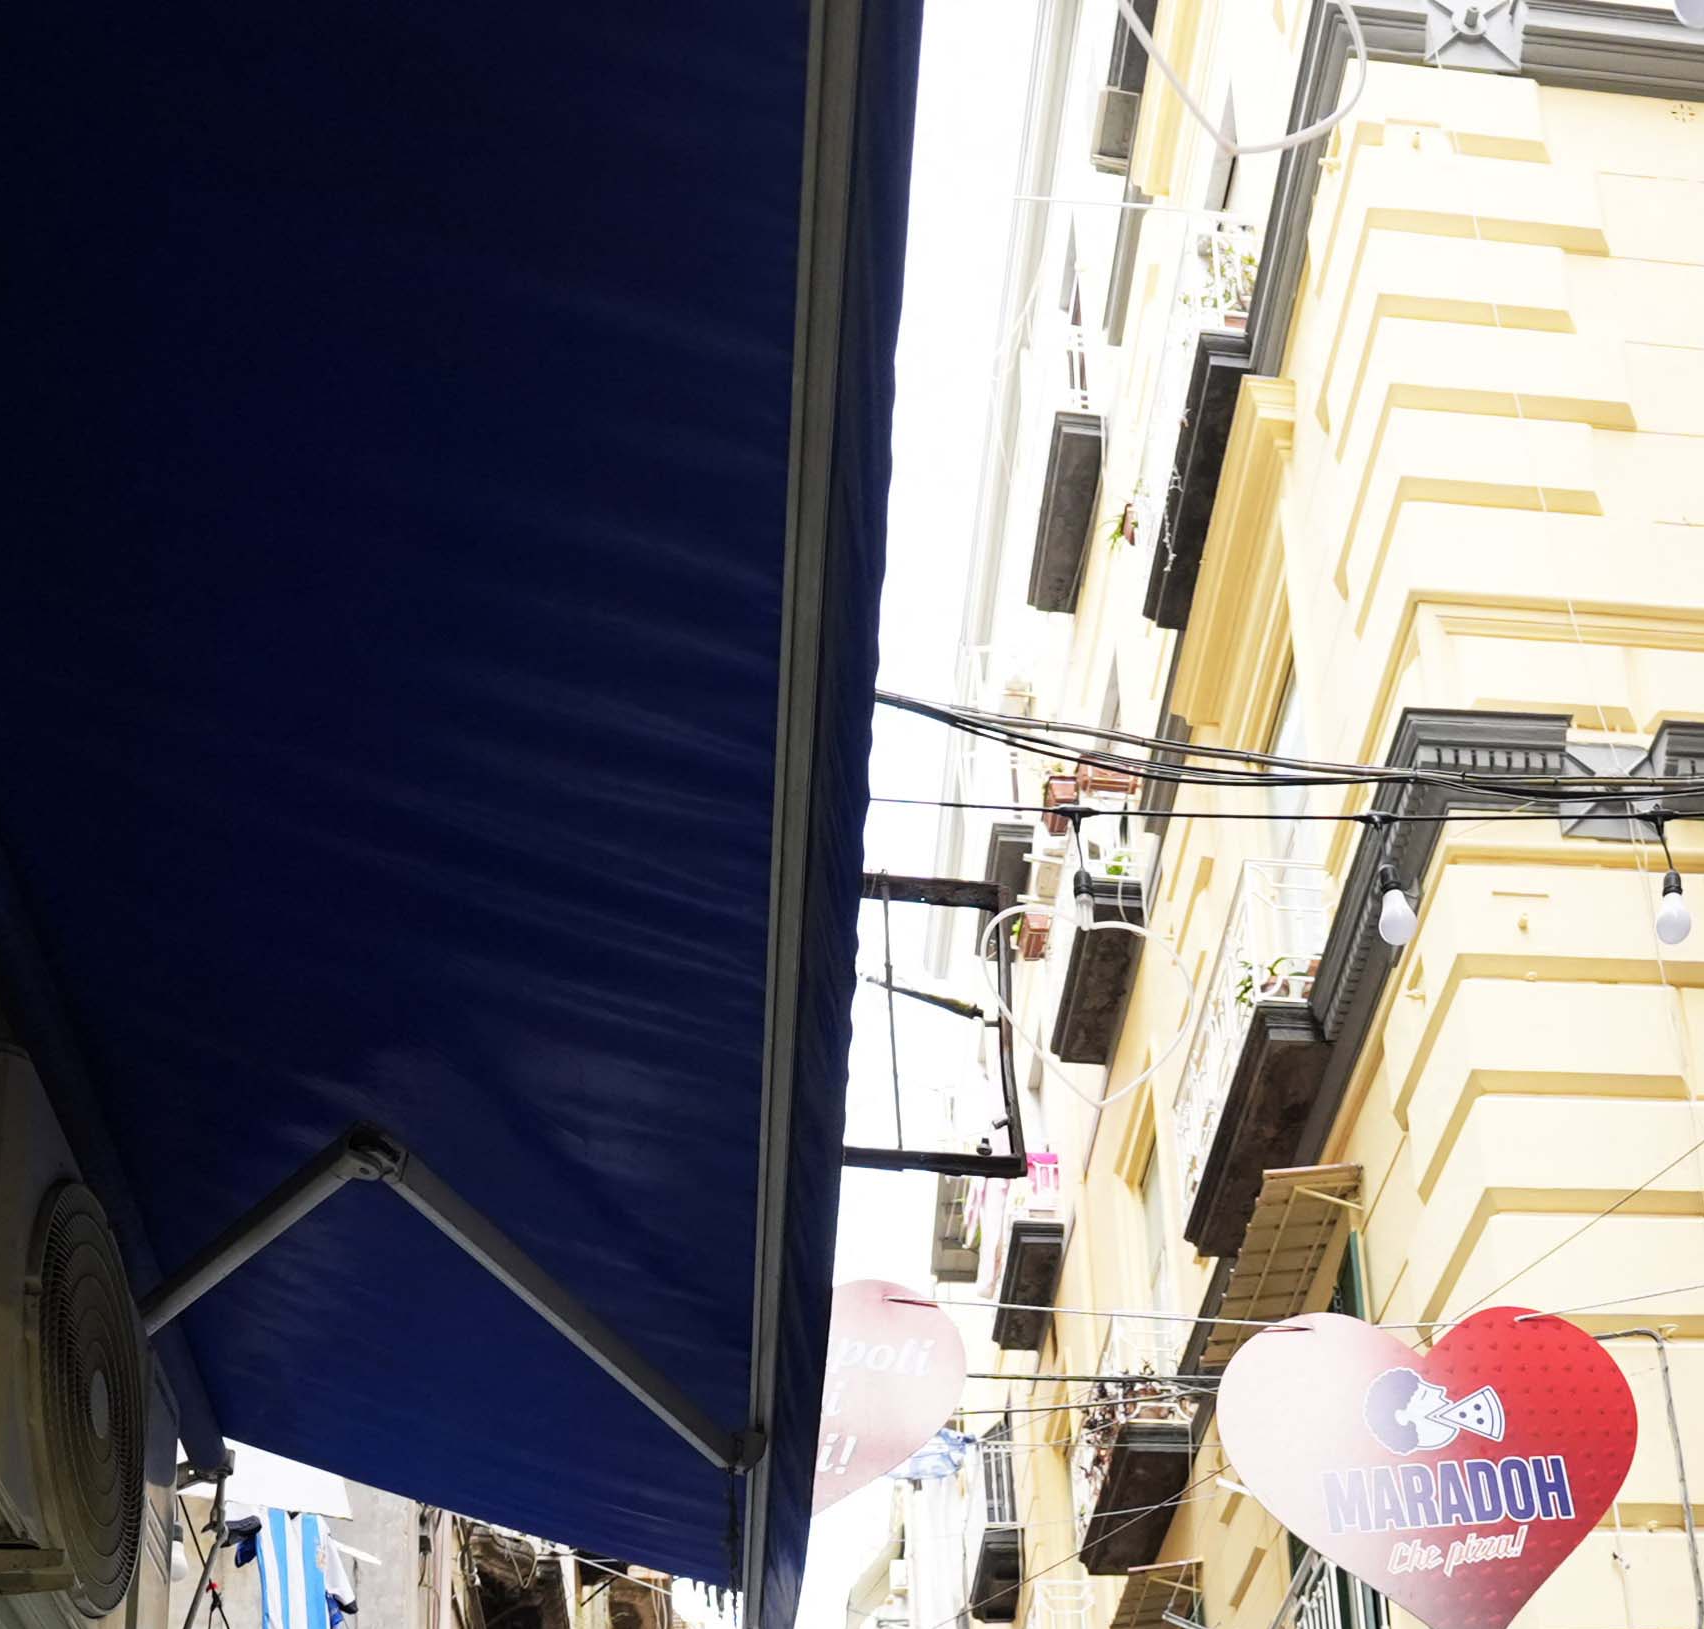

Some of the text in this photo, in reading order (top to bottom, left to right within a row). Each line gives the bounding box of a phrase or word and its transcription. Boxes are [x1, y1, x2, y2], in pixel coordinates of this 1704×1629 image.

[1321, 1456, 1575, 1534] MARADOH
[1387, 1525, 1528, 1577] Che pizza!
